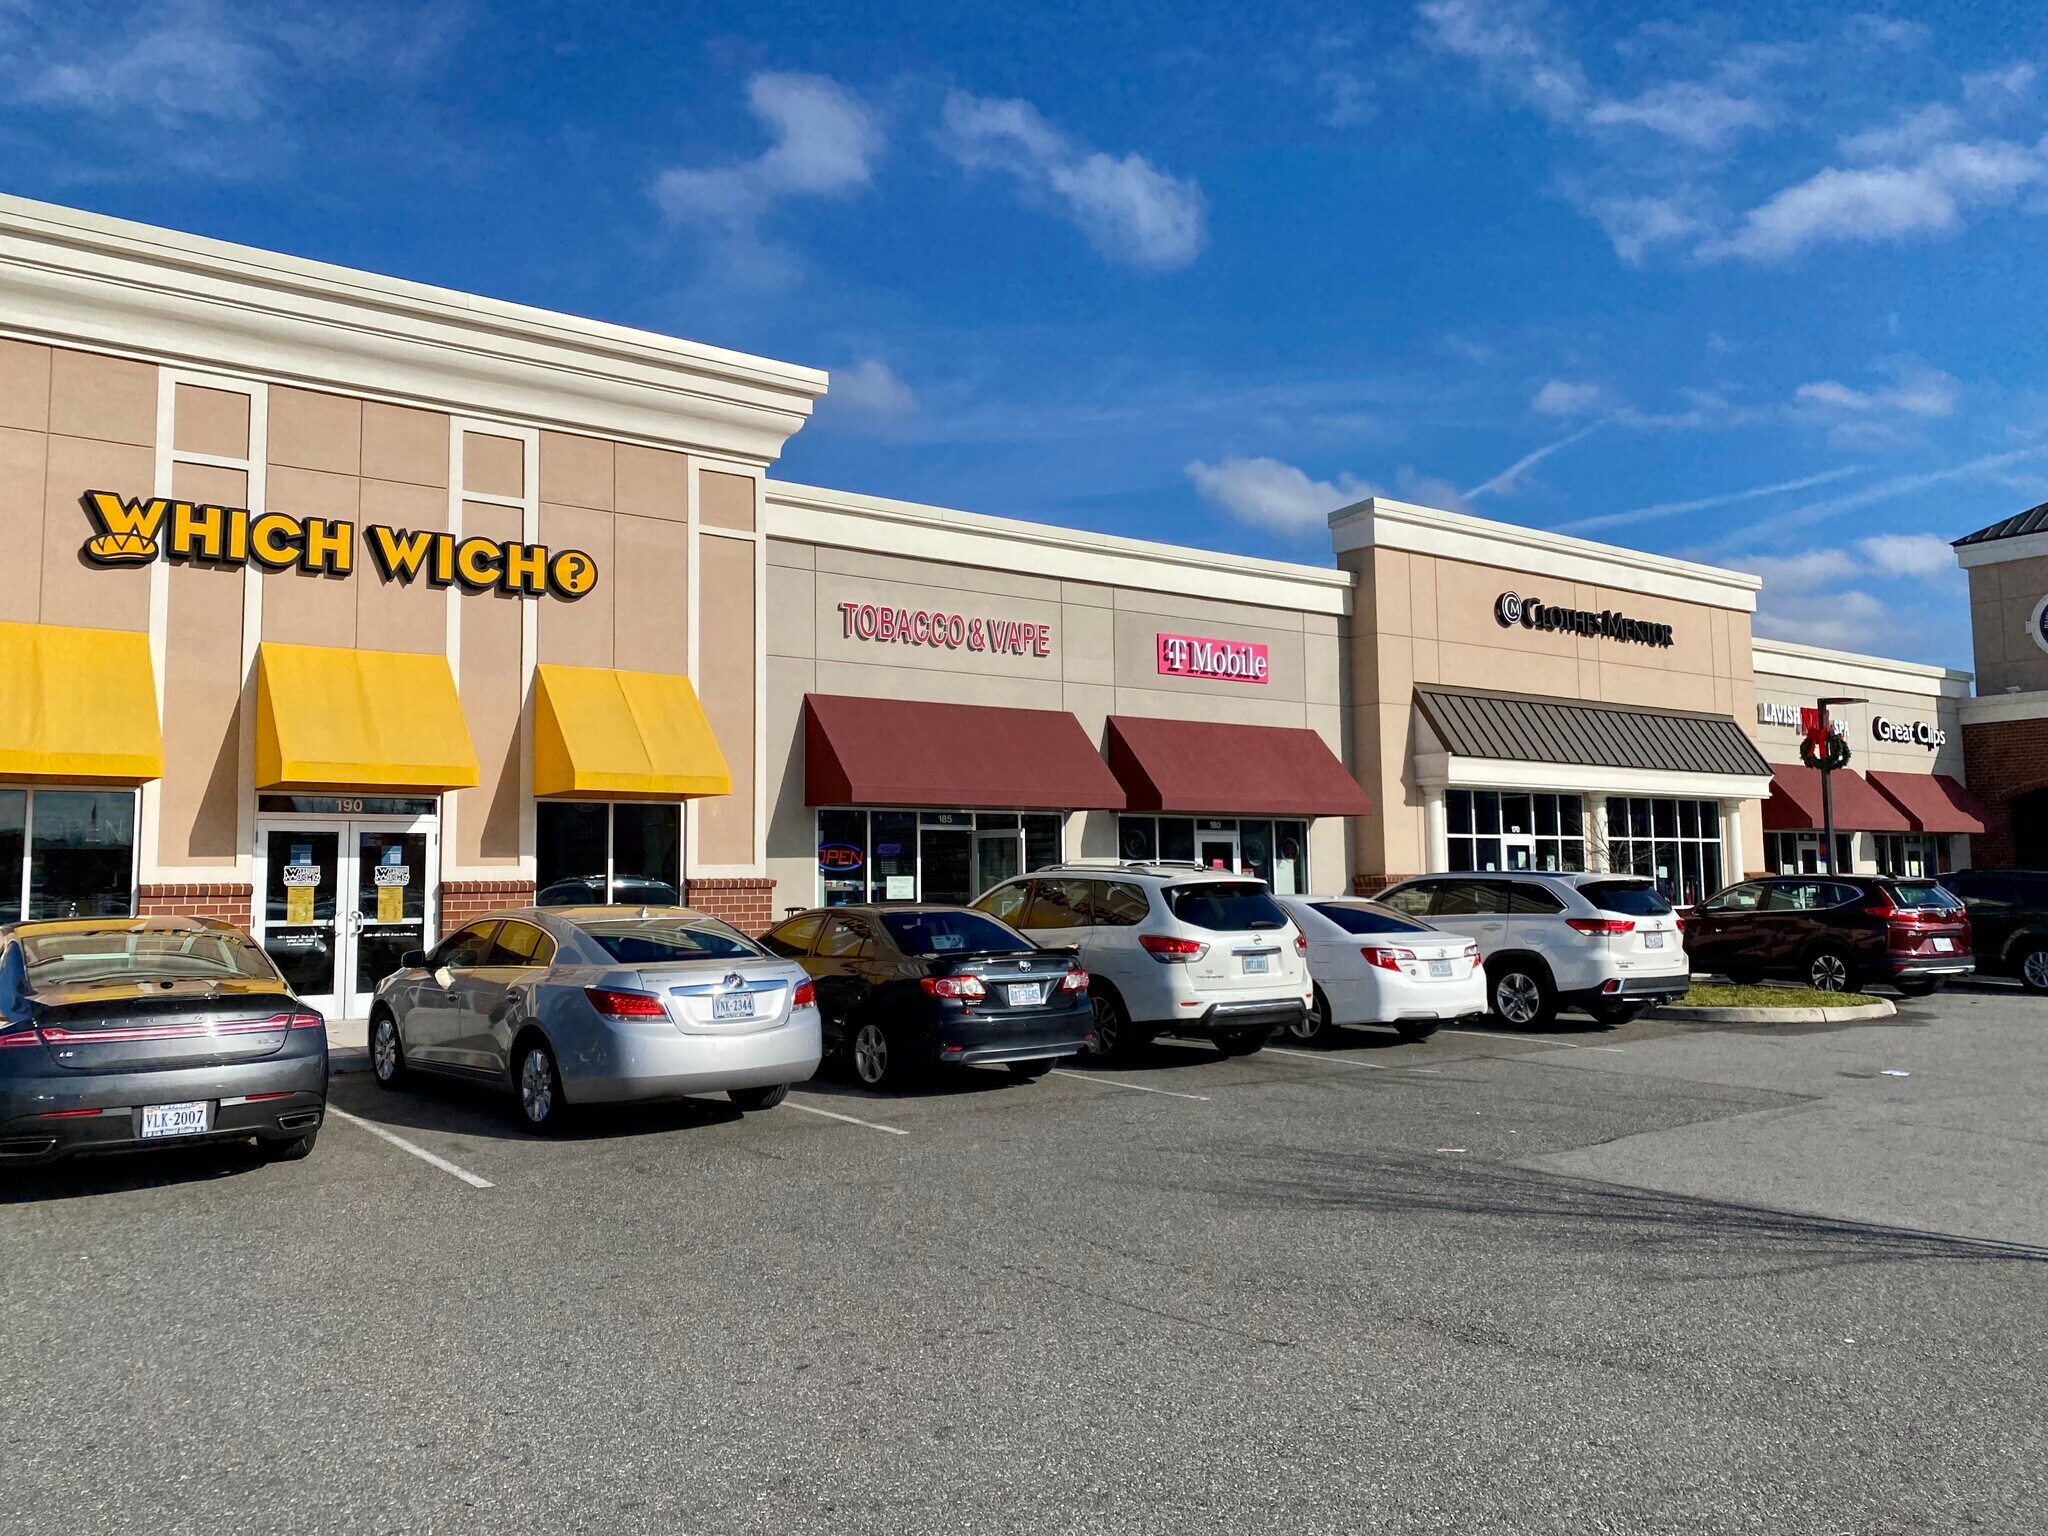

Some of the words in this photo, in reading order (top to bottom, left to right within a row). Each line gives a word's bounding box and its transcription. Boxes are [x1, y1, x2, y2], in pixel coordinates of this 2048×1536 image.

[84, 490, 354, 574] WHICH
[841, 602, 966, 648] TOBACCO
[969, 617, 986, 652] &
[989, 618, 1051, 657] VAPE
[1602, 610, 1675, 646] MENTOR
[1762, 702, 1801, 726] LAVISH
[1877, 716, 1915, 742] Great
[1917, 722, 1946, 749] Clips
[335, 799, 363, 812] 190
[938, 814, 953, 824] 185
[715, 999, 752, 1012] VNK-2344
[146, 1110, 204, 1128] VLK-2007
